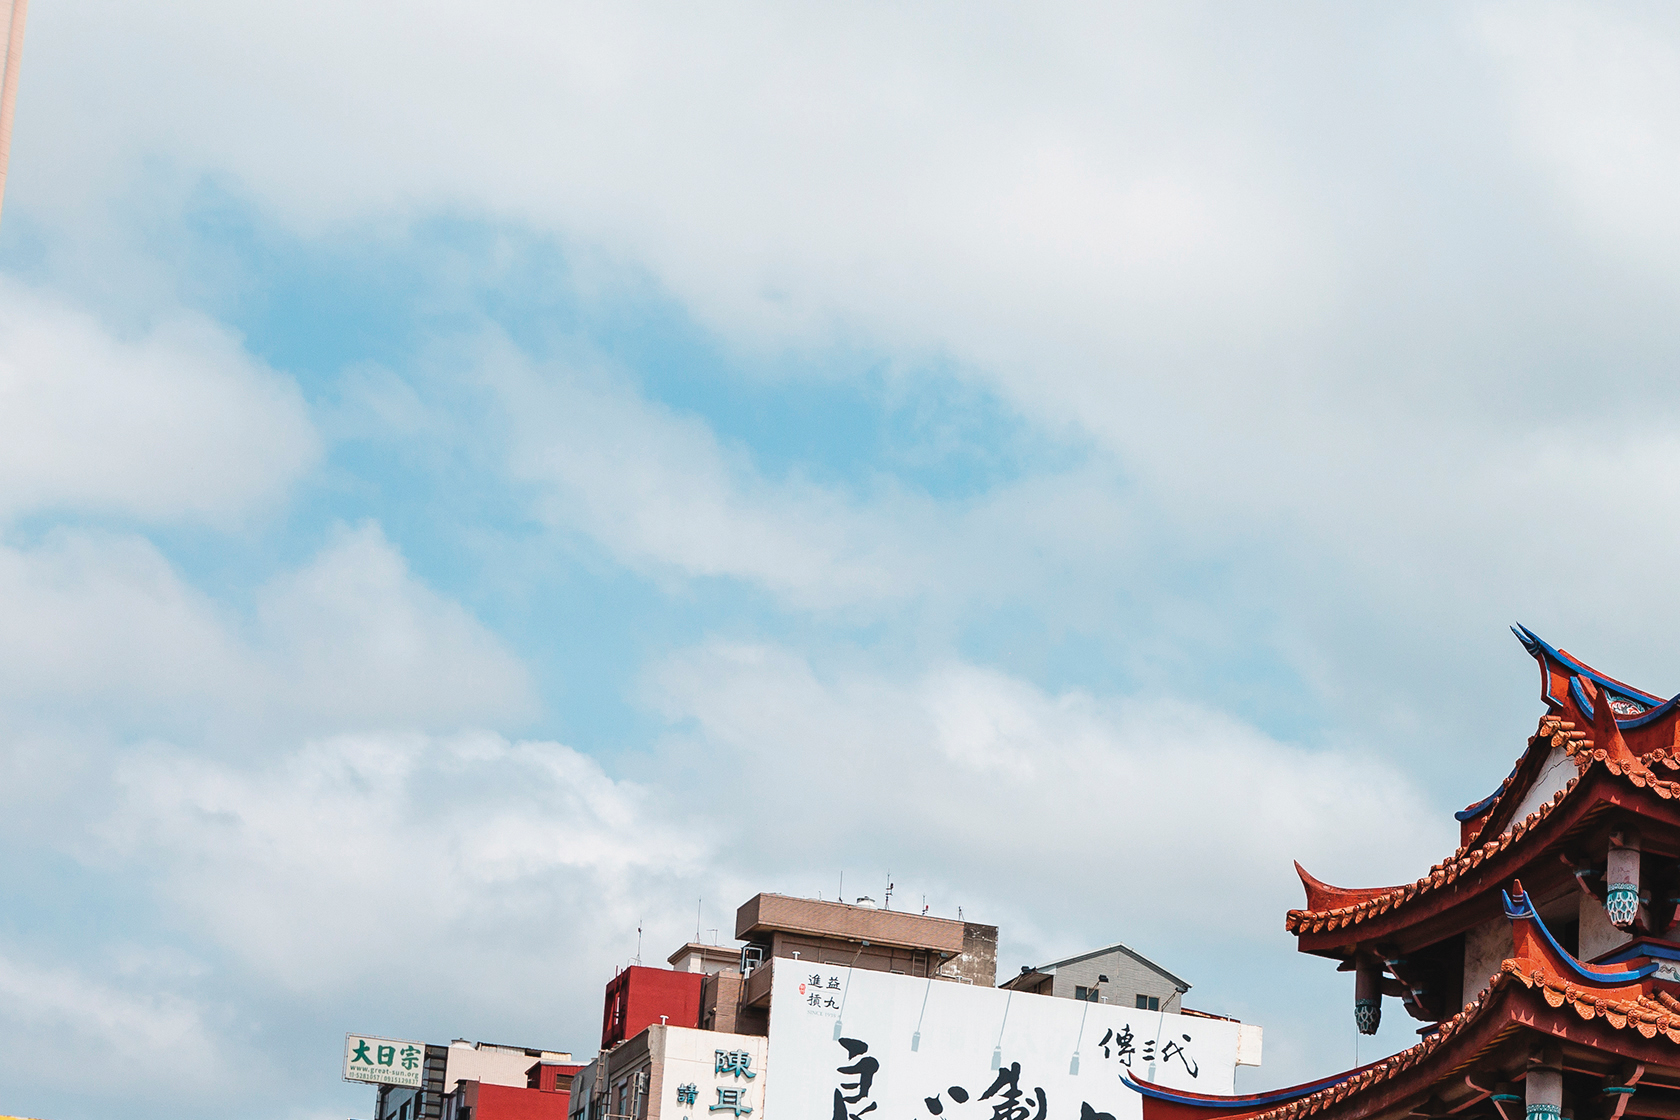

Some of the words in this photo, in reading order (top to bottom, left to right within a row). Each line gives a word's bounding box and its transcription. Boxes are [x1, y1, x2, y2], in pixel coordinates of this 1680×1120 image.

[351, 1039, 421, 1070] 大日宗
[1099, 1026, 1198, 1078] 傳三代
[350, 1065, 419, 1079] www.great-sun.org
